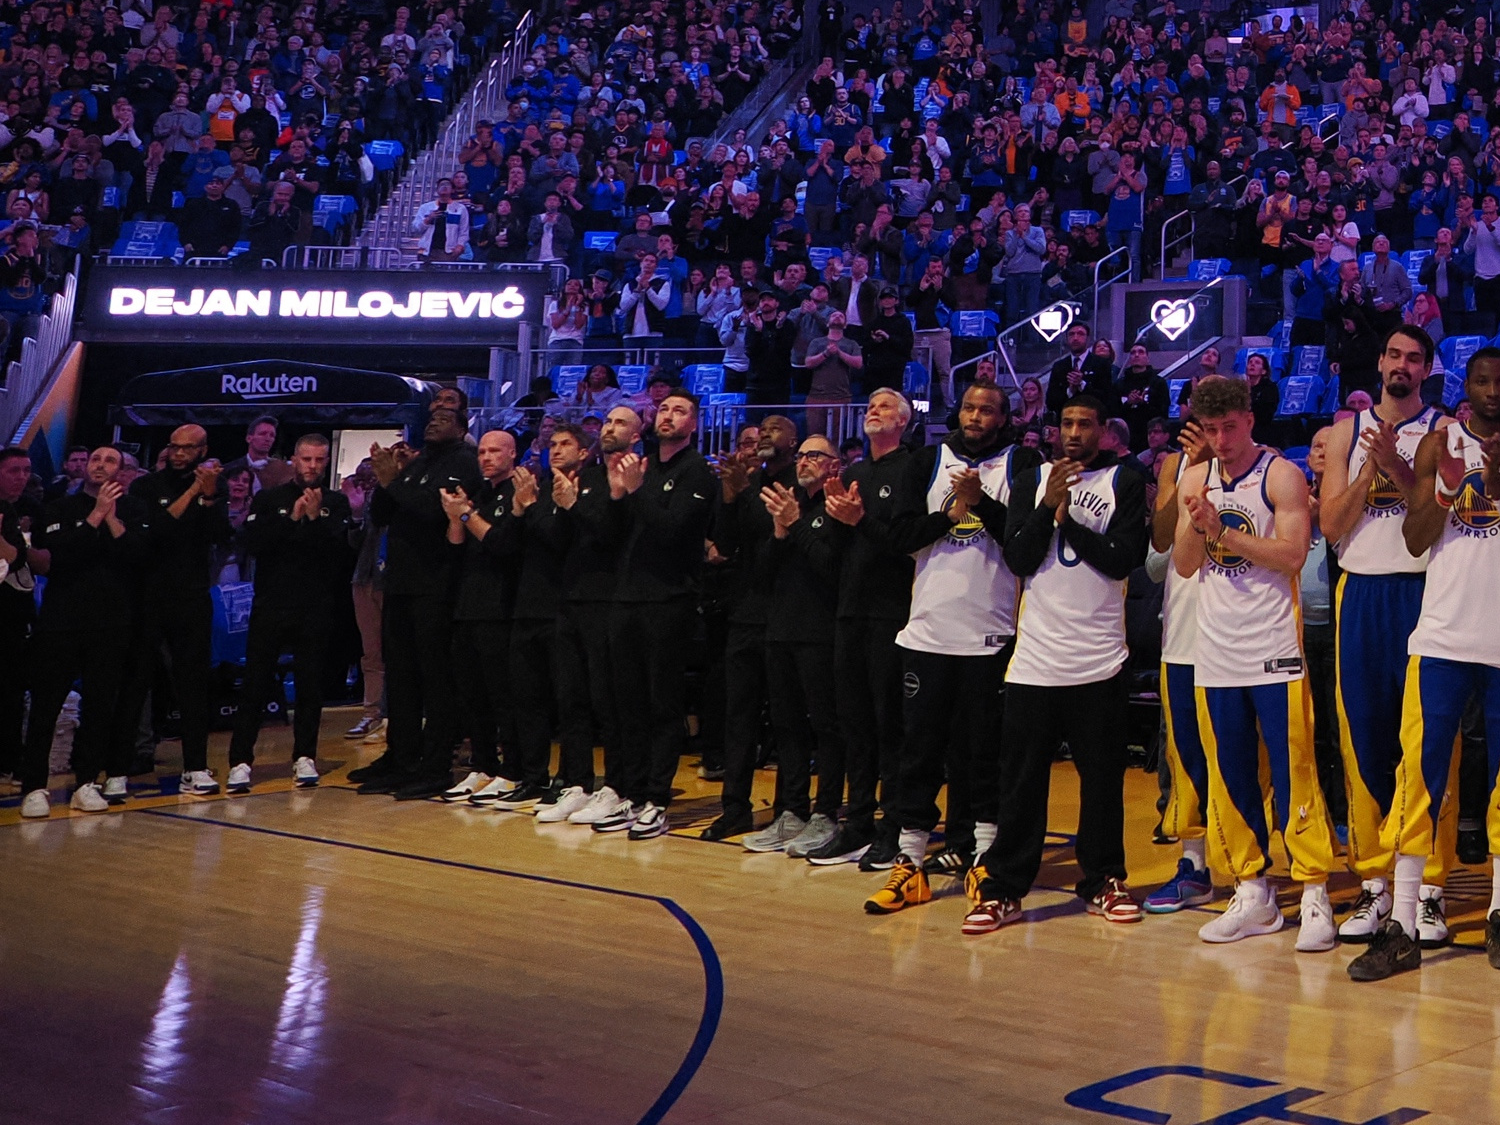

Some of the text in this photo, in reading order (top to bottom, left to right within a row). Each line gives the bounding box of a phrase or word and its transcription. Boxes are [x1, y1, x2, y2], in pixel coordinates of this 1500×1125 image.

[108, 286, 525, 319] DEJAN MILOJEVIĆ
[221, 373, 317, 398] Rakuten
[1399, 448, 1414, 464] TATE
[1073, 490, 1111, 518] JEVIĆ
[1364, 501, 1408, 519] ARRIOR
[944, 531, 988, 548] ARRIOR
[1206, 559, 1255, 579] ARRIOR
